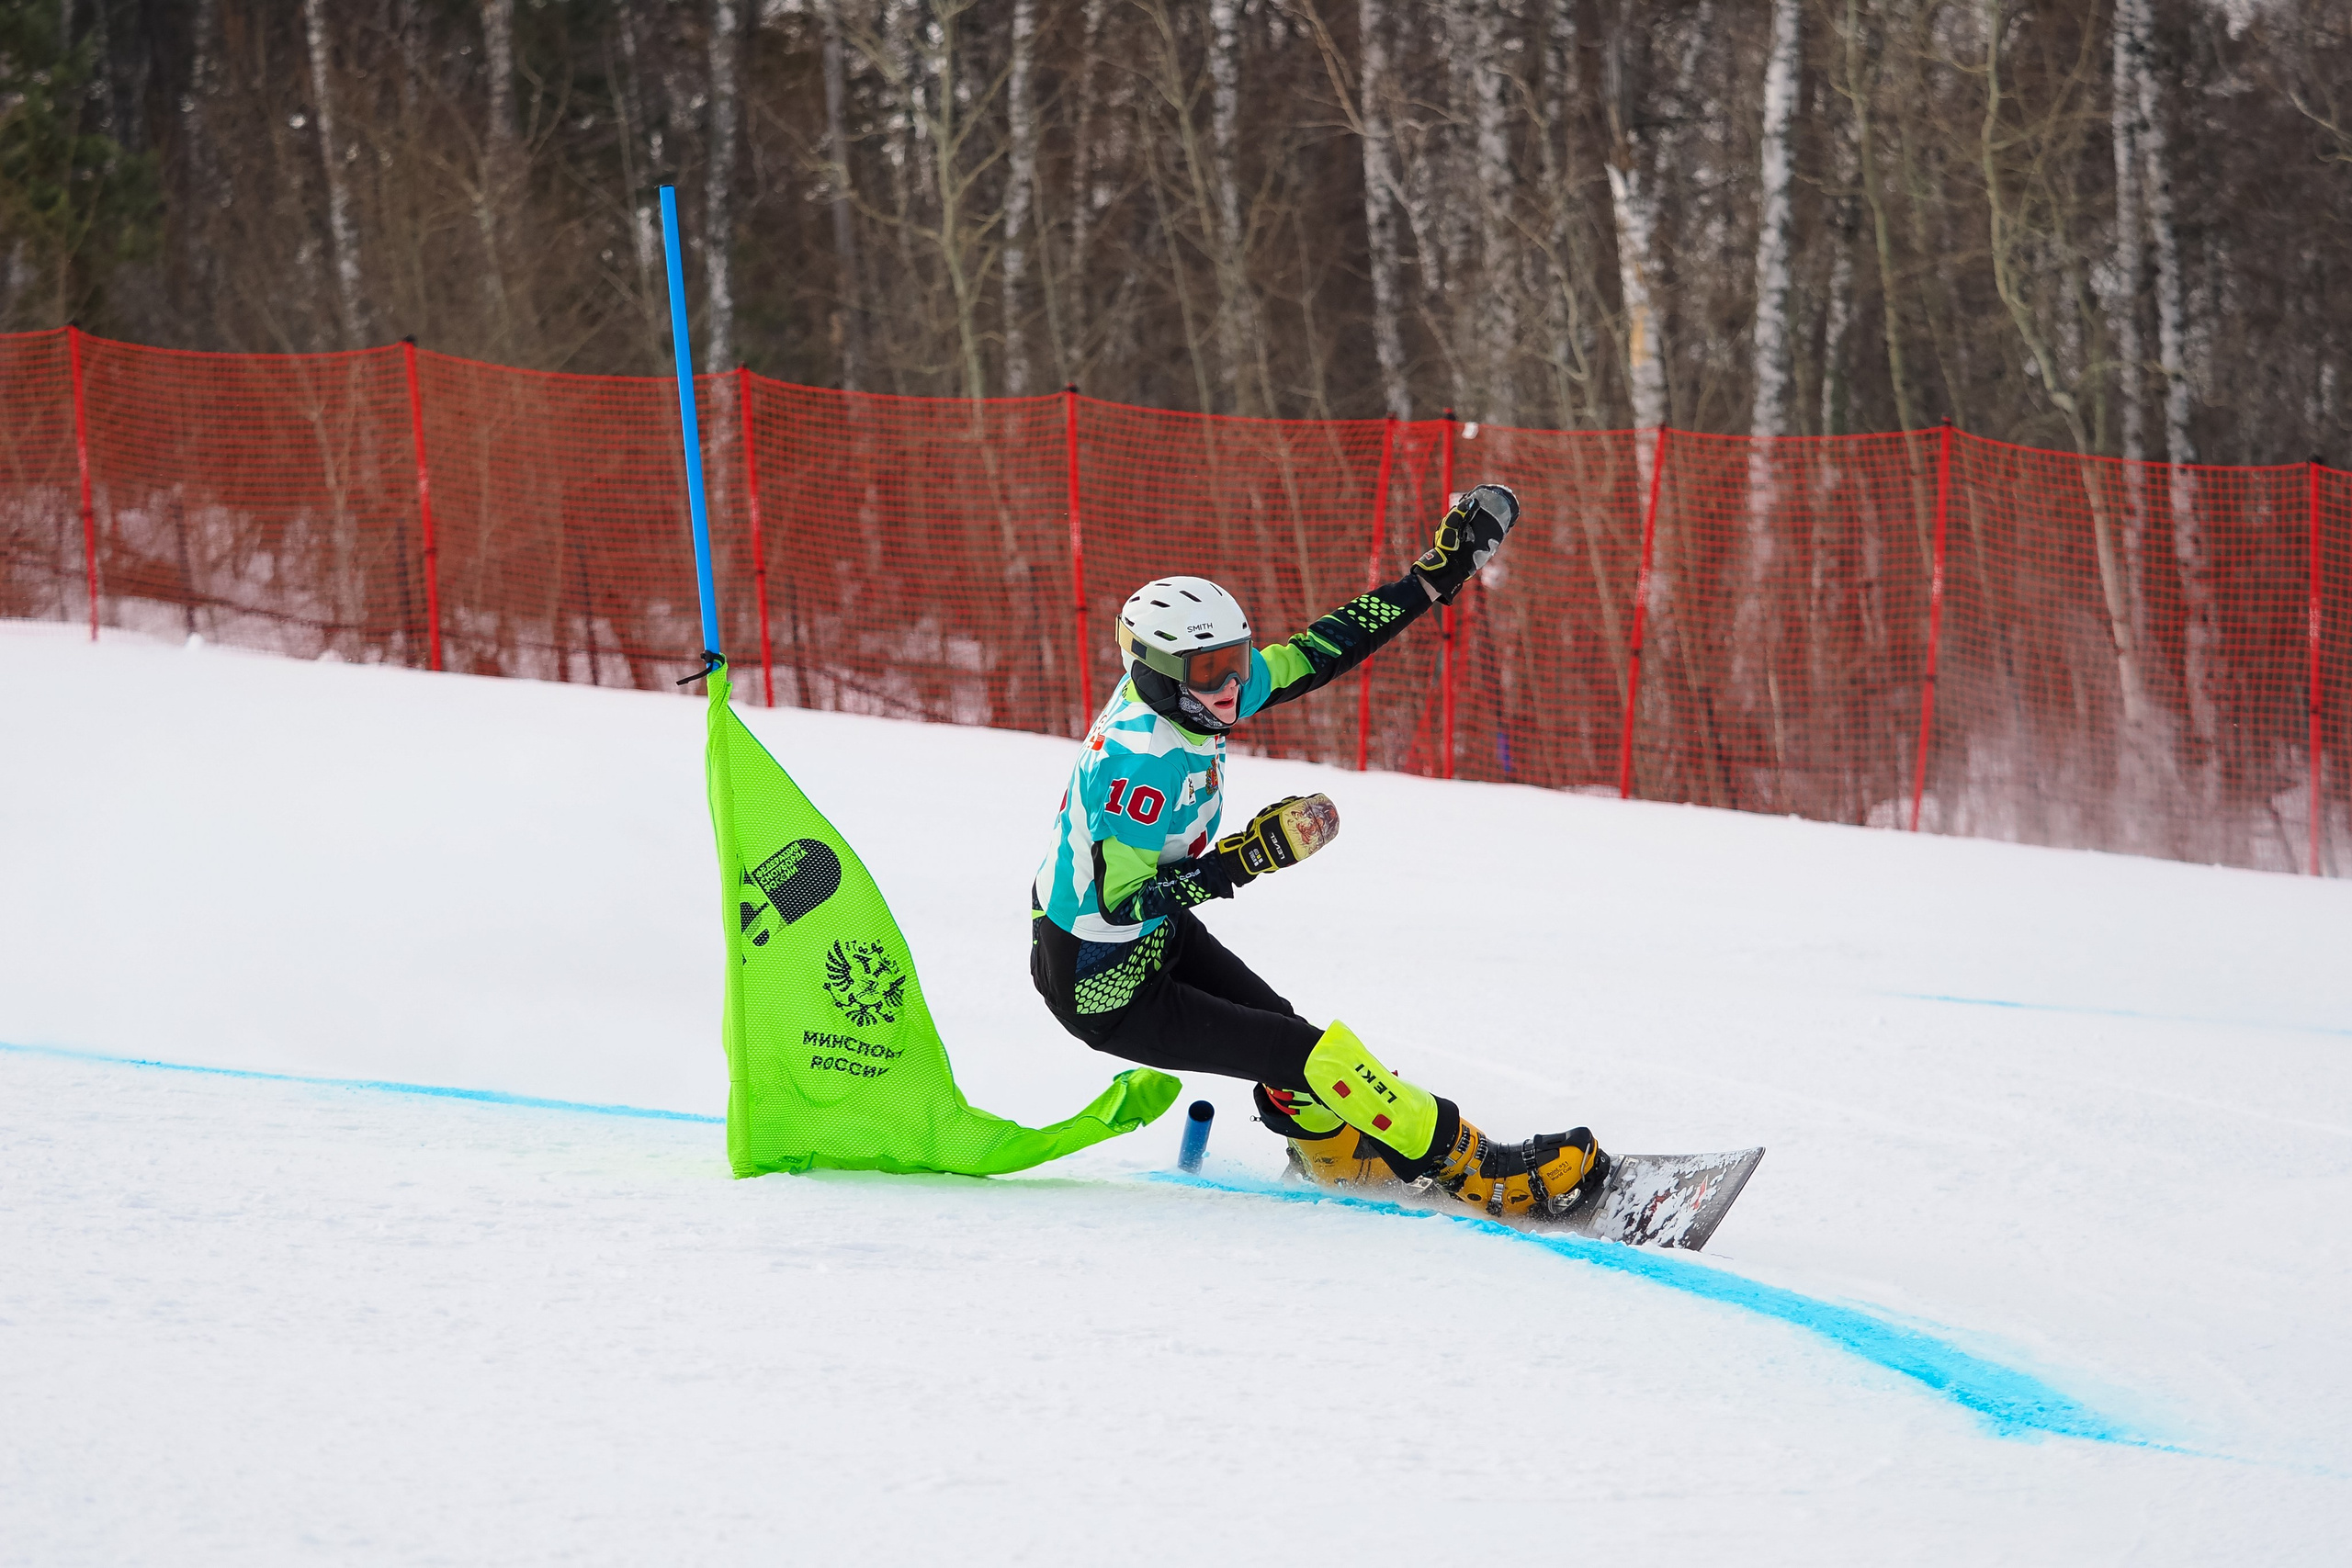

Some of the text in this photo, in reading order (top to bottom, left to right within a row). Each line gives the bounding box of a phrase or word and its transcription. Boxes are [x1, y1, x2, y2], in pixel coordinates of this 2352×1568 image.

[1186, 622, 1213, 633] SMITH
[1103, 777, 1167, 826] 10
[1270, 831, 1285, 860] LEVEL
[760, 850, 808, 885] СНОУБОРДА
[763, 864, 798, 892] РОССИИ
[1354, 1063, 1397, 1104] LEKI
